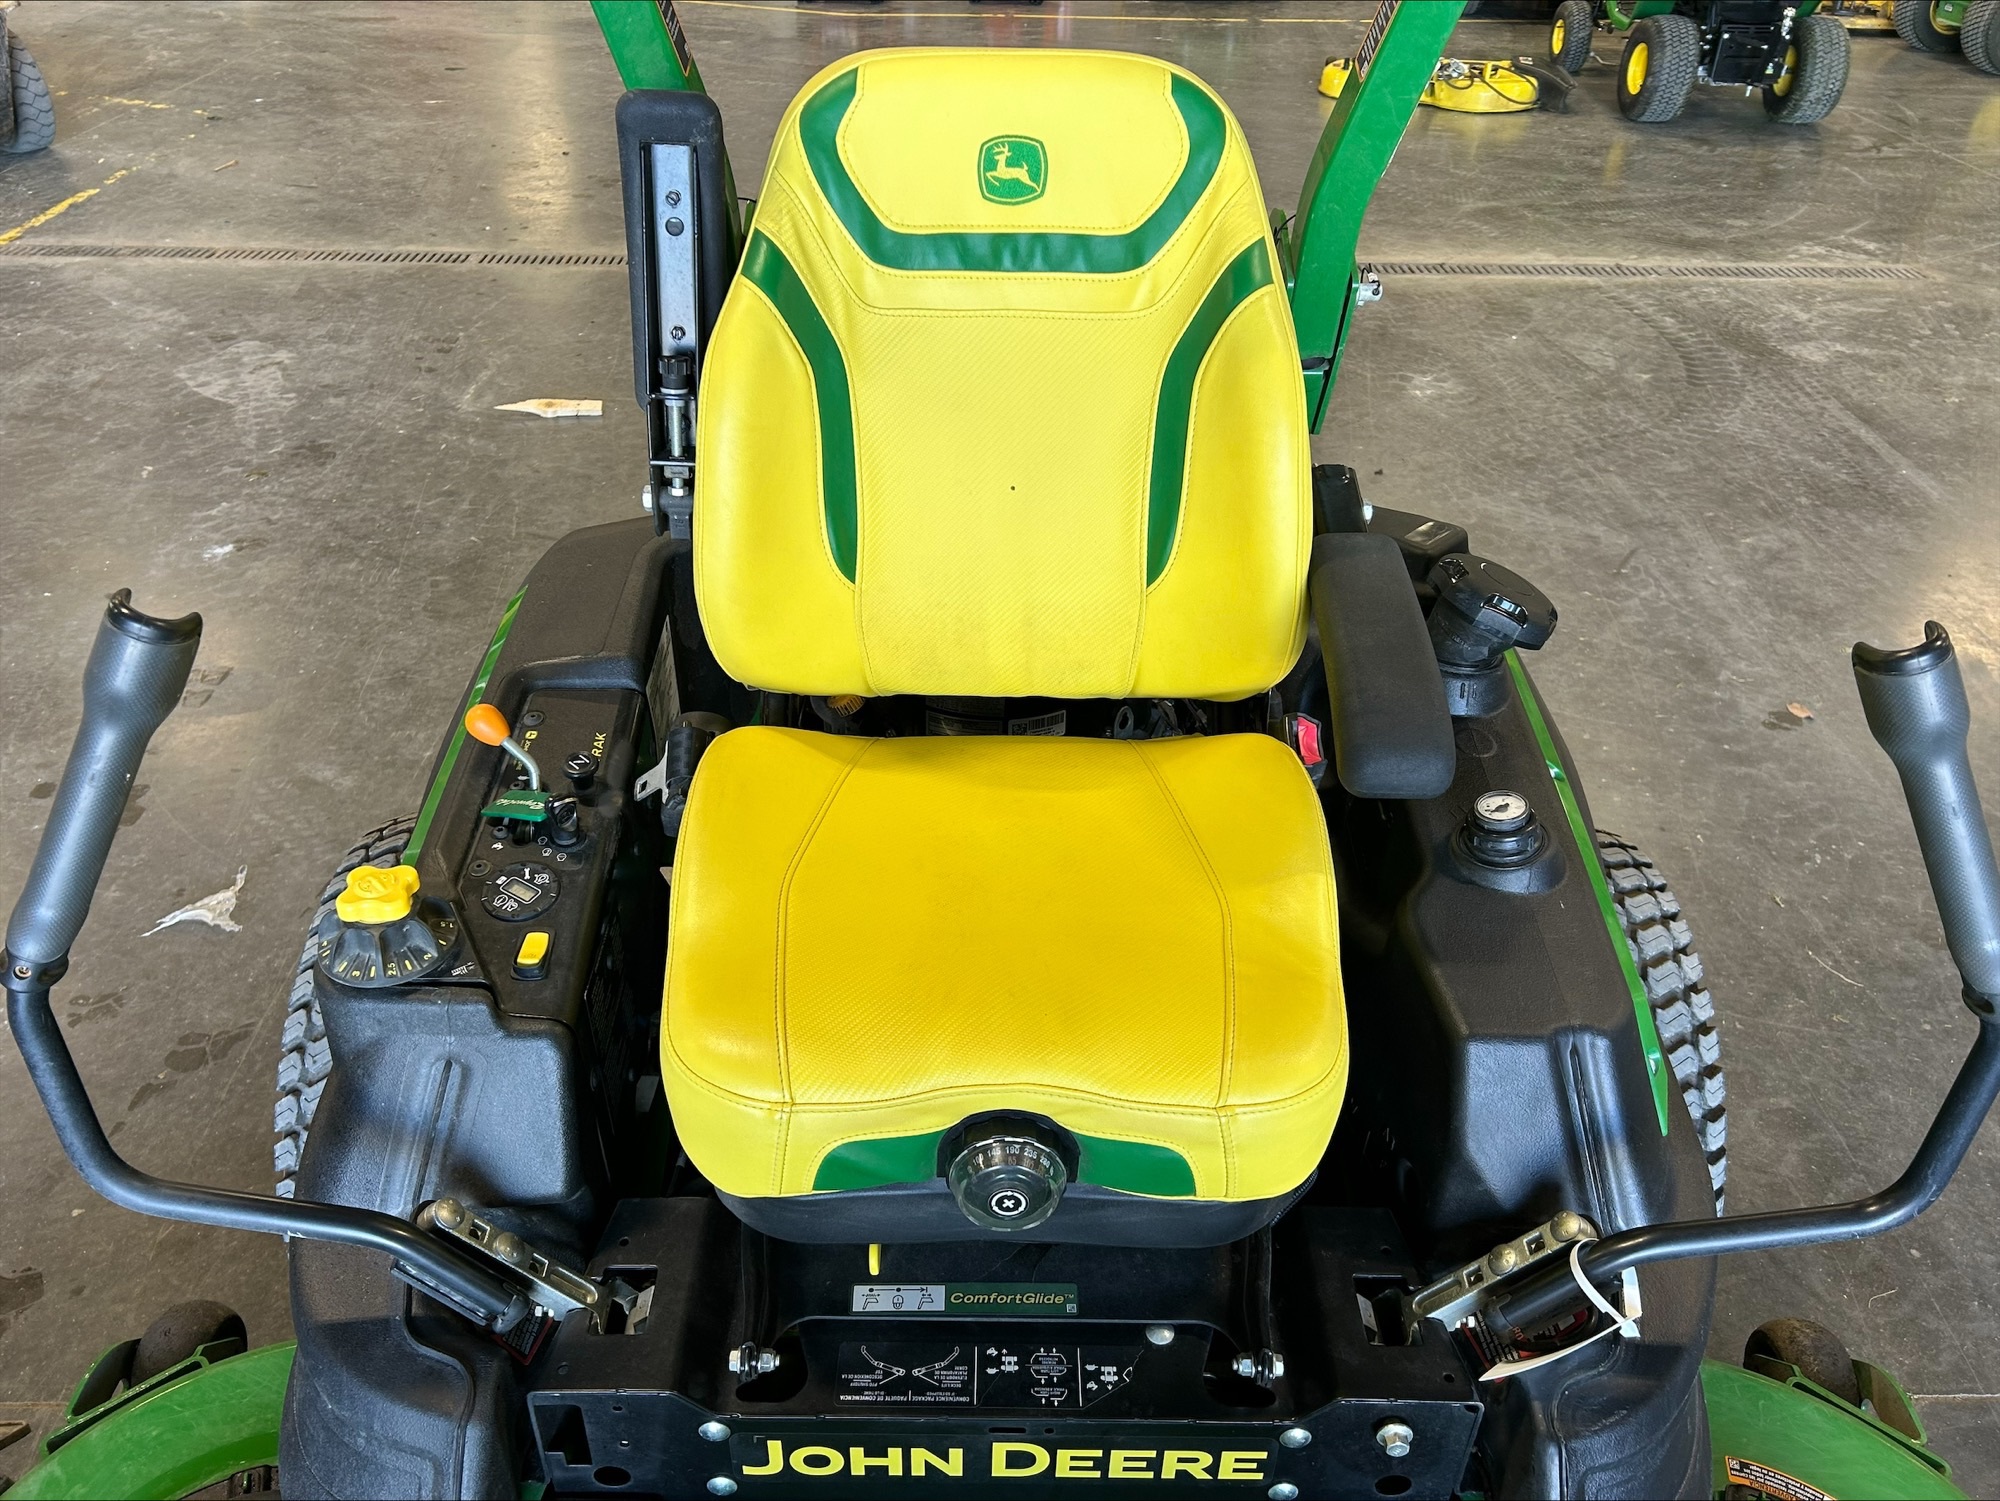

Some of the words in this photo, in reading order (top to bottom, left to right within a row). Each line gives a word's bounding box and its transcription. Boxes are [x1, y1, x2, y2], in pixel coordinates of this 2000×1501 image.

[591, 731, 608, 761] RAK
[423, 953, 432, 961] 2
[387, 962, 397, 976] 2.5
[987, 1147, 1001, 1157] 145
[1005, 1146, 1020, 1154] 190
[1023, 1147, 1037, 1159] 235
[742, 1438, 964, 1478] JOHN
[989, 1441, 1269, 1481] DEERE
